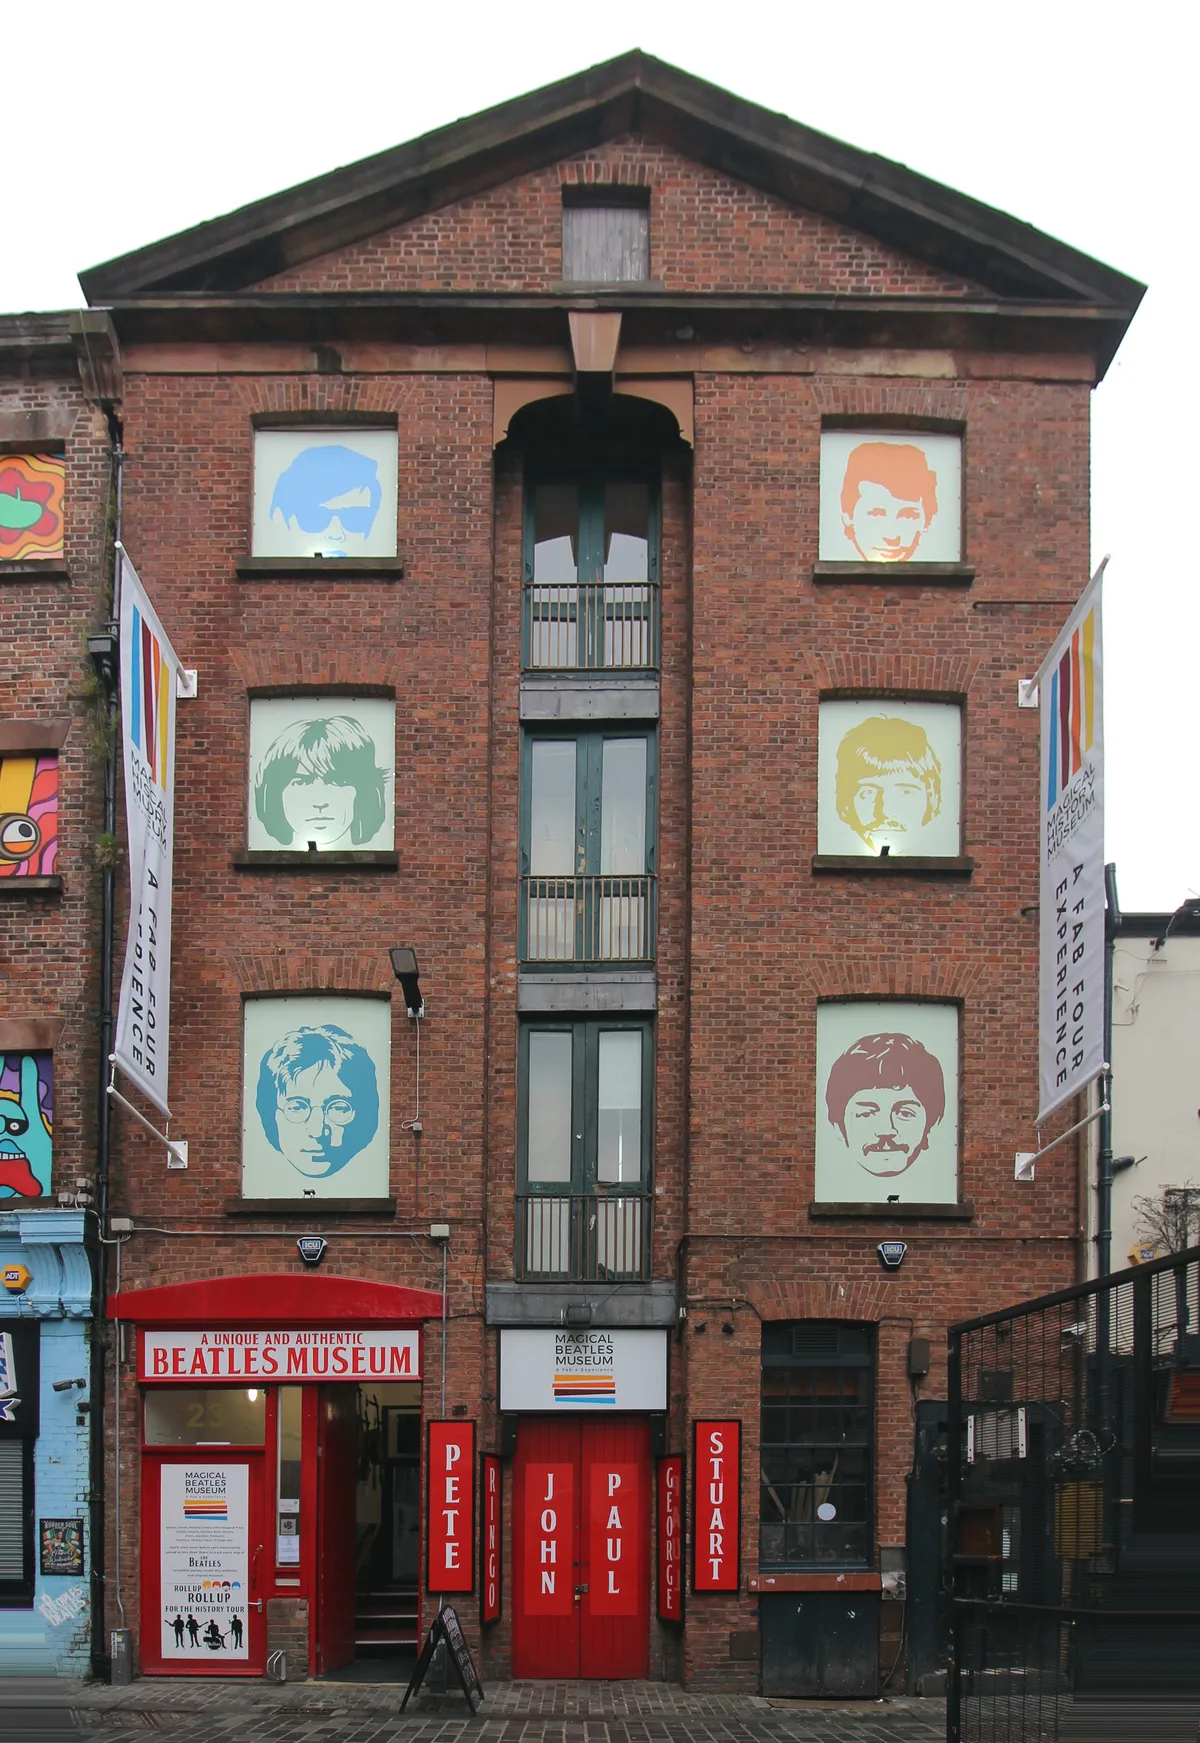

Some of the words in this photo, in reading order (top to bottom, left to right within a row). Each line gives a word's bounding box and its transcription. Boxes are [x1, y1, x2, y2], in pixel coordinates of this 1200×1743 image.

[1046, 762, 1096, 832] MAGICAL
[1047, 774, 1095, 846] HISTORY
[1047, 789, 1095, 860] MUSEUM
[148, 867, 158, 890] A
[1073, 864, 1084, 885] A
[148, 906, 158, 972] FAB
[1072, 898, 1084, 964] FAB
[1056, 877, 1068, 1088] EXPERIENCE
[146, 987, 156, 1077] FOUR
[1072, 978, 1084, 1071] FOUR
[5, 1272, 19, 1280] ADT
[153, 1347, 279, 1374] BEATLES
[287, 1347, 411, 1374] MUSEUM
[201, 1334, 208, 1345] A
[214, 1333, 259, 1345] UNIQUE
[265, 1333, 290, 1345] AND
[296, 1332, 363, 1345] AUTHENTIC
[556, 1334, 613, 1344] MAGICAL
[556, 1345, 614, 1354] BEATLES
[556, 1356, 613, 1365] MUSEUM
[442, 1444, 461, 1568] PETE
[541, 1473, 557, 1594] JOHN
[606, 1473, 622, 1594] PAUL
[708, 1432, 724, 1580] STUART
[189, 1557, 222, 1567] BEATLES
[188, 1593, 214, 1603] ROLL
[217, 1593, 231, 1603] UP
